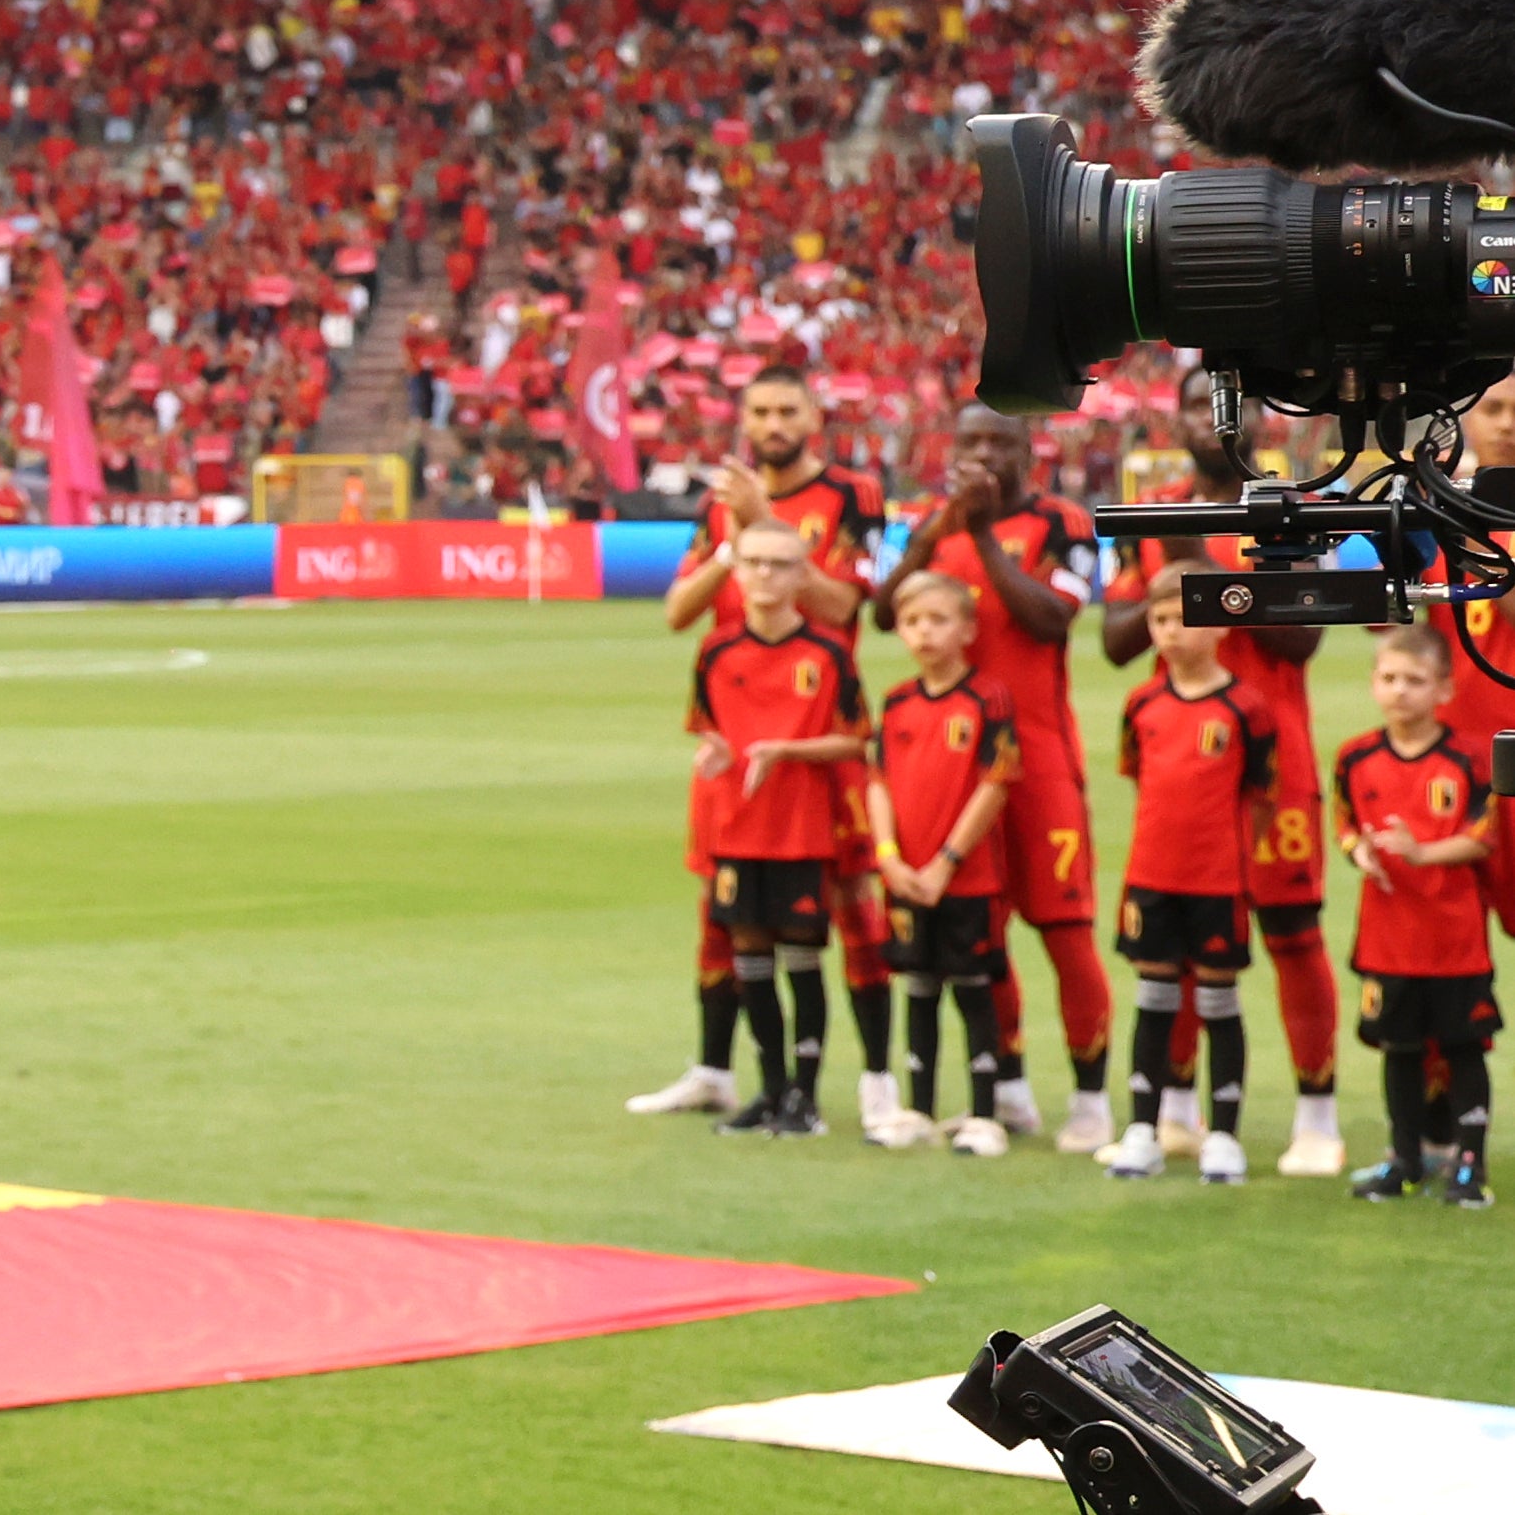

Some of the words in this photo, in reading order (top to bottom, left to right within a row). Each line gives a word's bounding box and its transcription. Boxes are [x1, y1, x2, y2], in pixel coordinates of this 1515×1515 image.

[1494, 275, 1515, 295] N
[296, 545, 357, 582] ING
[441, 544, 517, 582] ING
[1048, 828, 1080, 882] 7
